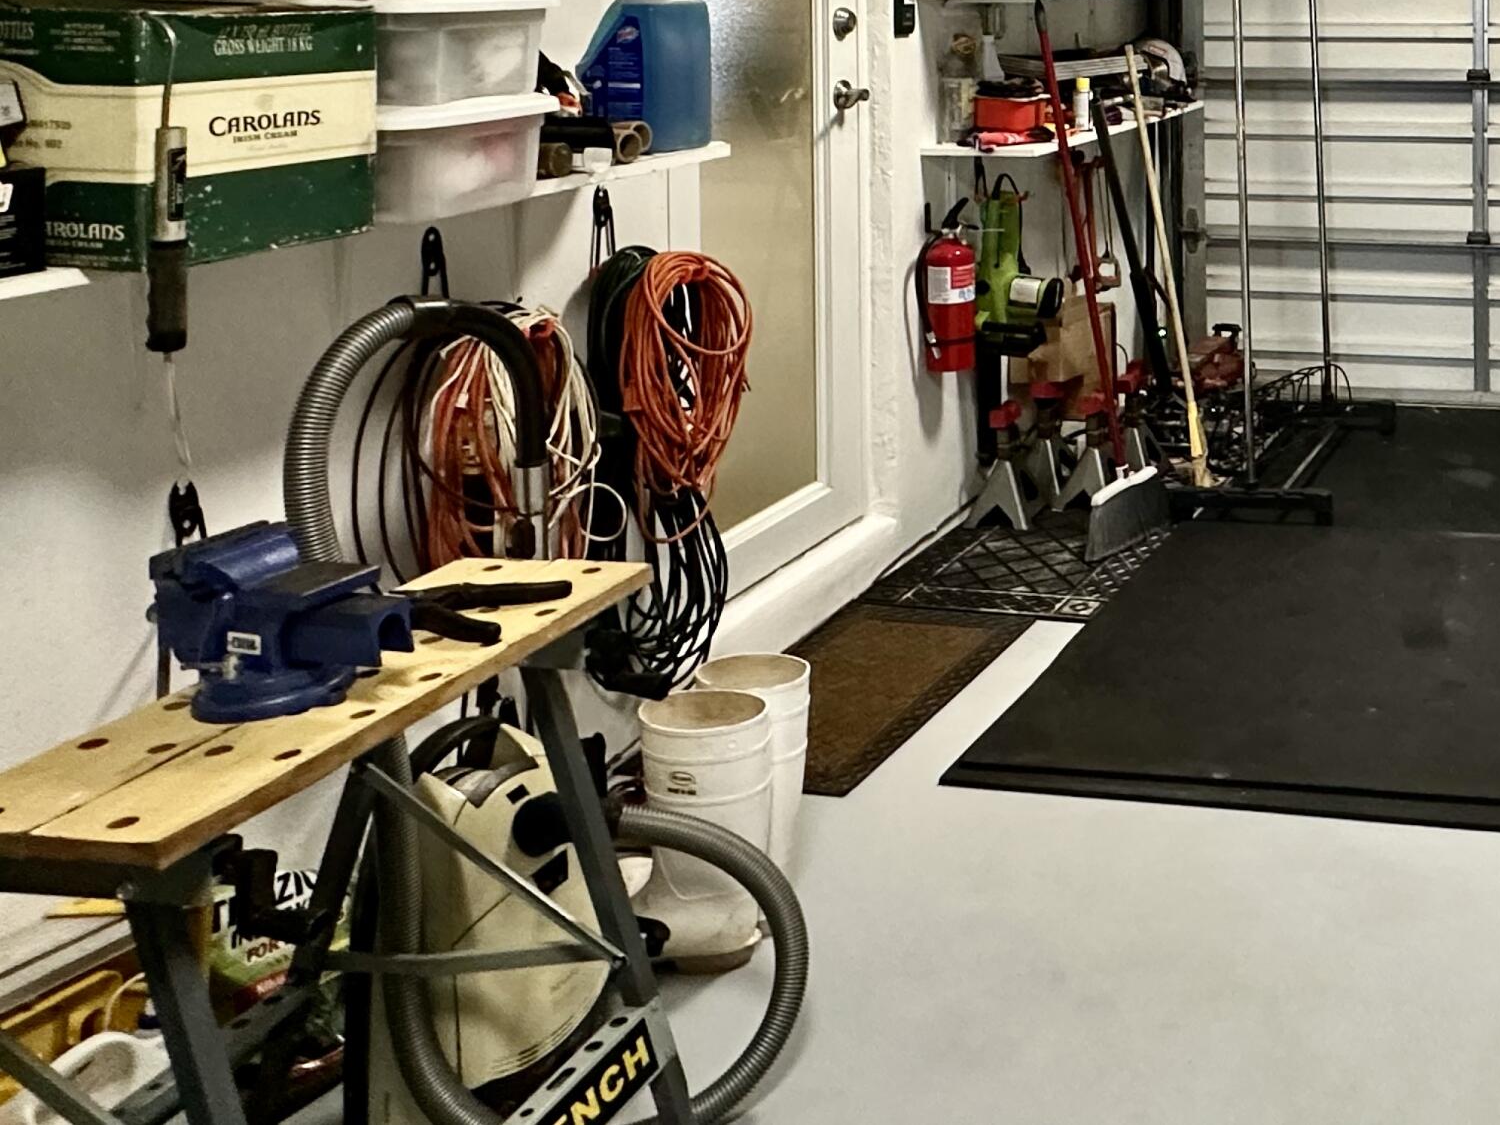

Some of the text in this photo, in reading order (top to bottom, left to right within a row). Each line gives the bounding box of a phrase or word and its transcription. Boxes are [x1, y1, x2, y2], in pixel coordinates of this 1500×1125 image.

[213, 39, 245, 56] GROSS
[246, 36, 285, 54] WEIGHT
[209, 109, 322, 137] CAROLANS
[233, 130, 298, 144] IRISH CREAM
